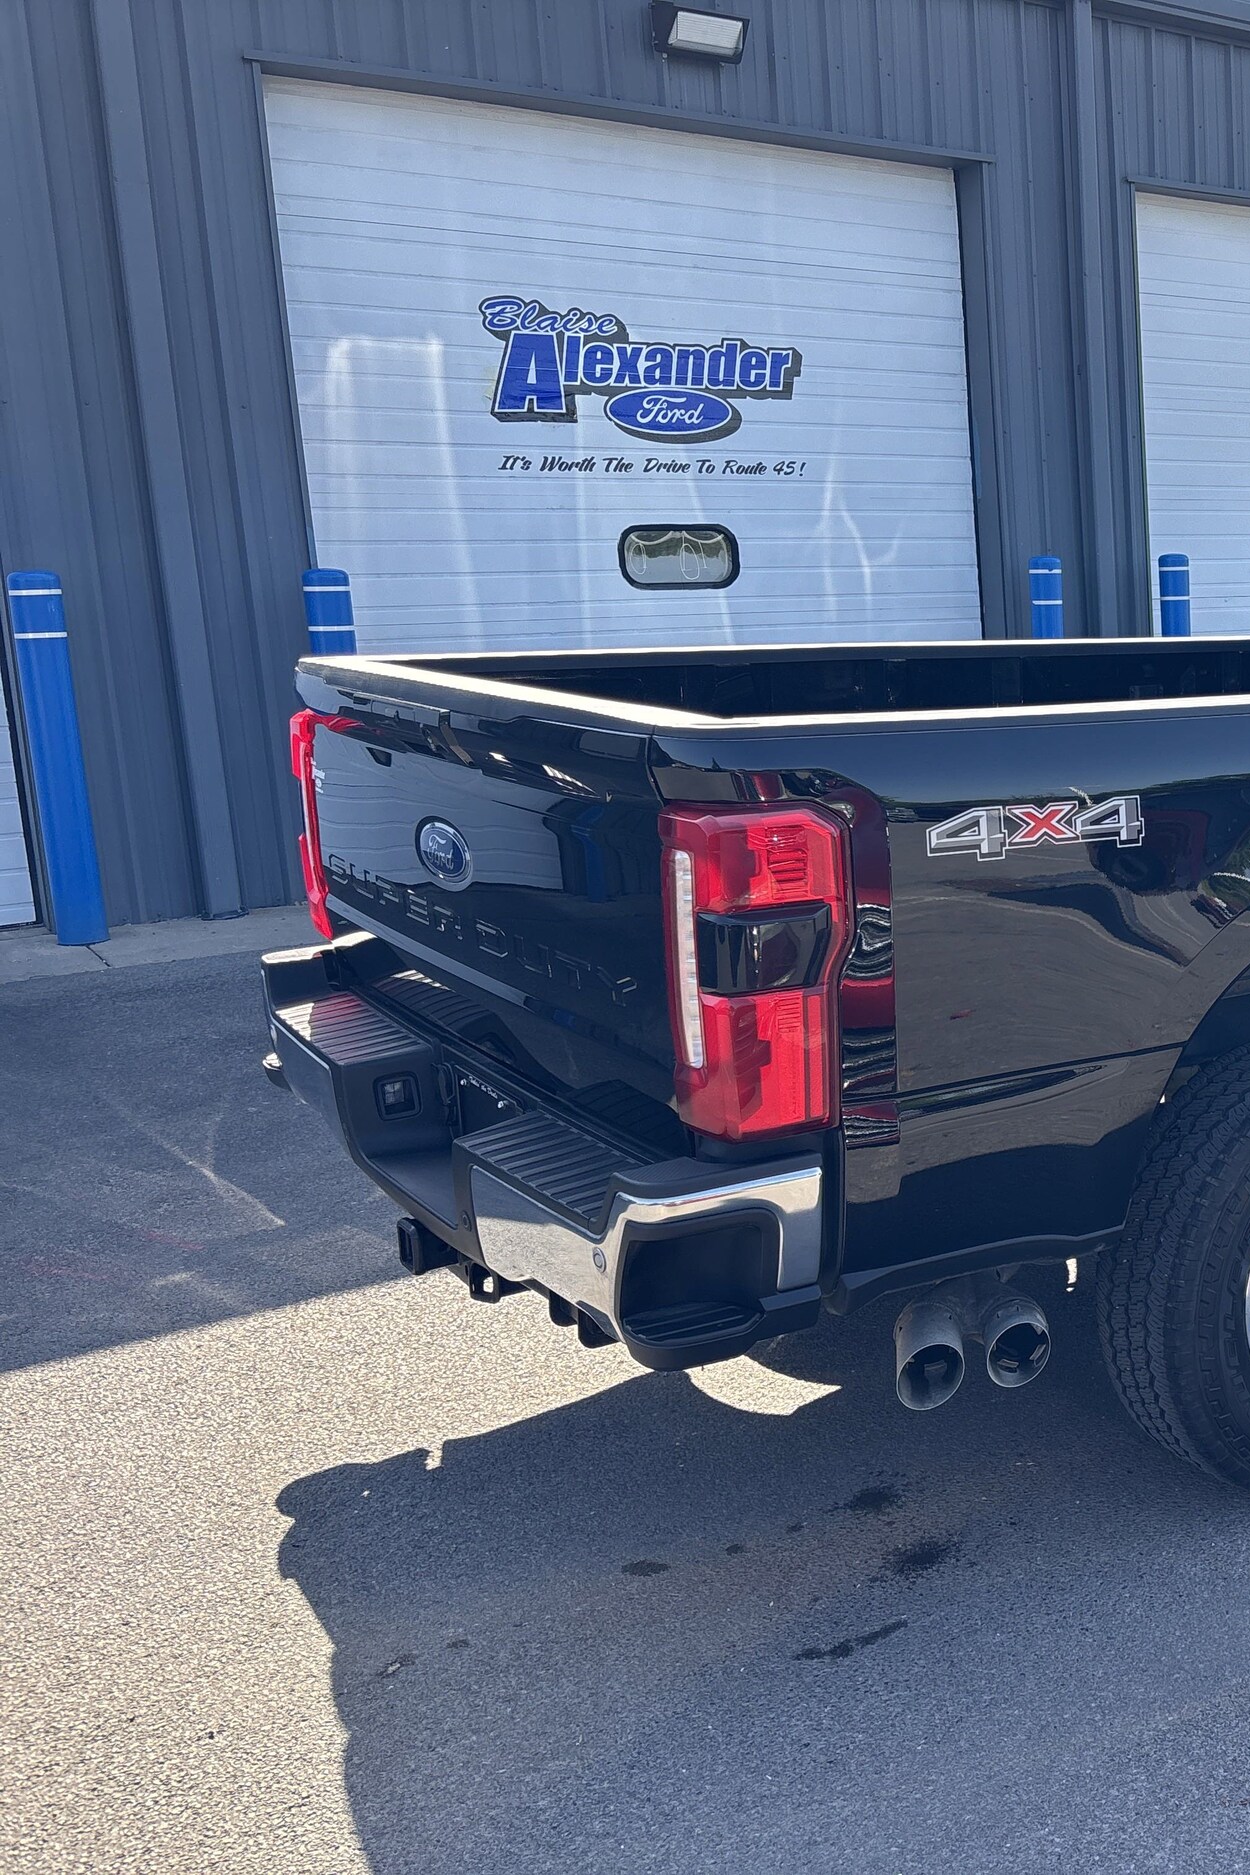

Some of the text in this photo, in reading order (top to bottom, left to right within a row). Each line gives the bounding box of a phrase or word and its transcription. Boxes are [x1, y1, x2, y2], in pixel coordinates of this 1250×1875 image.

[482, 298, 619, 335] Blaise
[494, 331, 794, 413] Alexander
[636, 393, 704, 425] Ford
[498, 454, 532, 471] It's
[539, 456, 596, 474] Worth
[602, 457, 634, 474] The
[642, 457, 691, 474] Drive
[697, 458, 716, 475] To
[721, 459, 767, 476] Route
[428, 834, 454, 870] Ford
[328, 853, 639, 1007] SUPER DUTY
